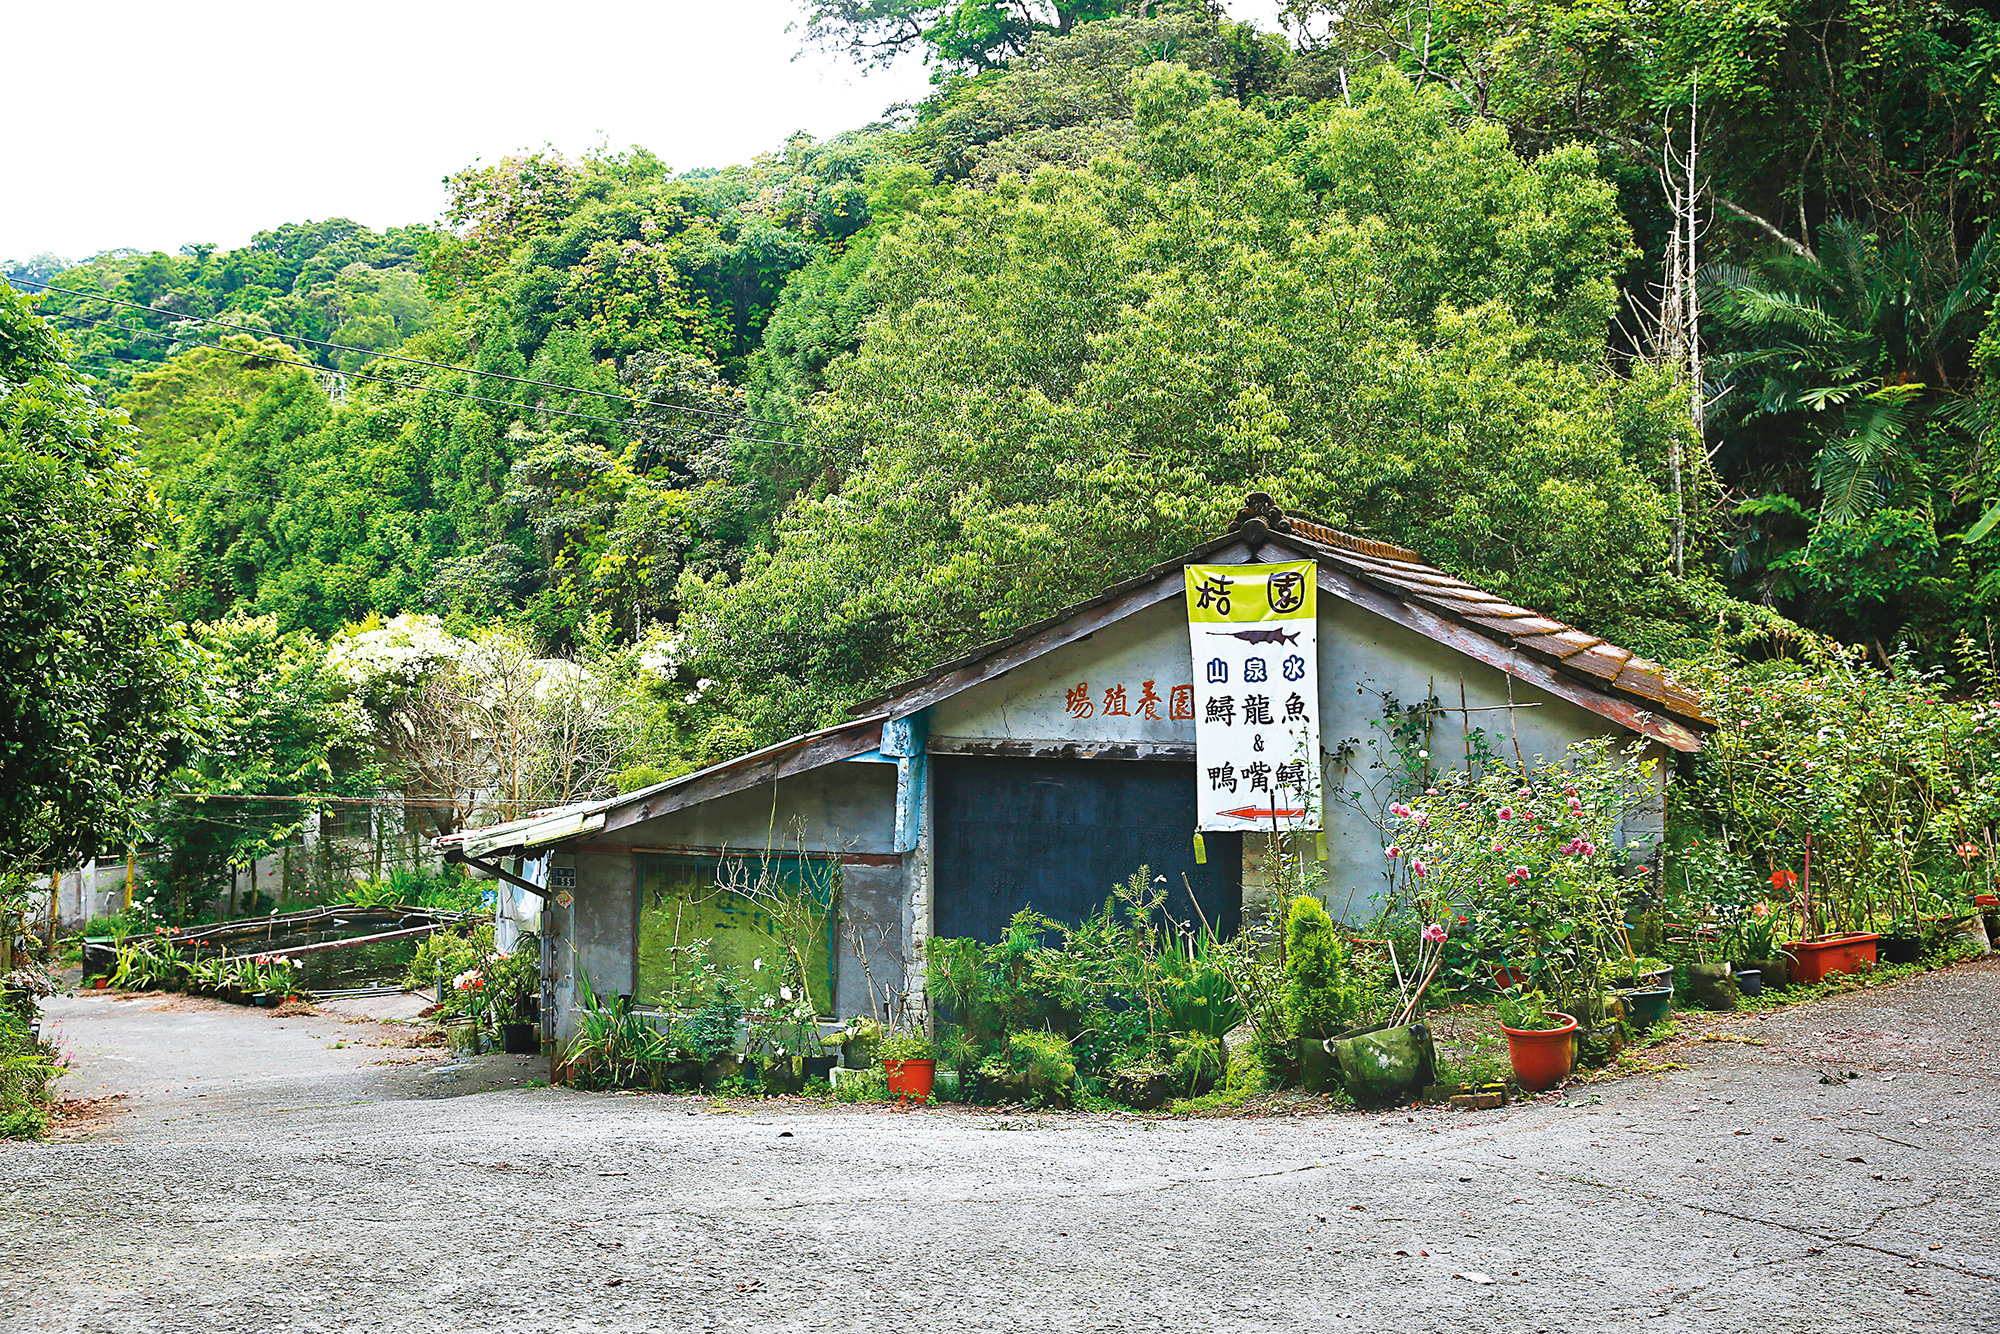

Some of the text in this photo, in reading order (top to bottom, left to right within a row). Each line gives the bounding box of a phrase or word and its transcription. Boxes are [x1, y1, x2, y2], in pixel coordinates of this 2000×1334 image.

[1195, 571, 1305, 616] 桔園
[1206, 654, 1306, 684] 山泉水
[1204, 692, 1310, 727] 鱘龍魚
[1252, 733, 1265, 752] &
[1206, 761, 1307, 794] 鴨嘴鱘
[561, 877, 571, 886] 55
